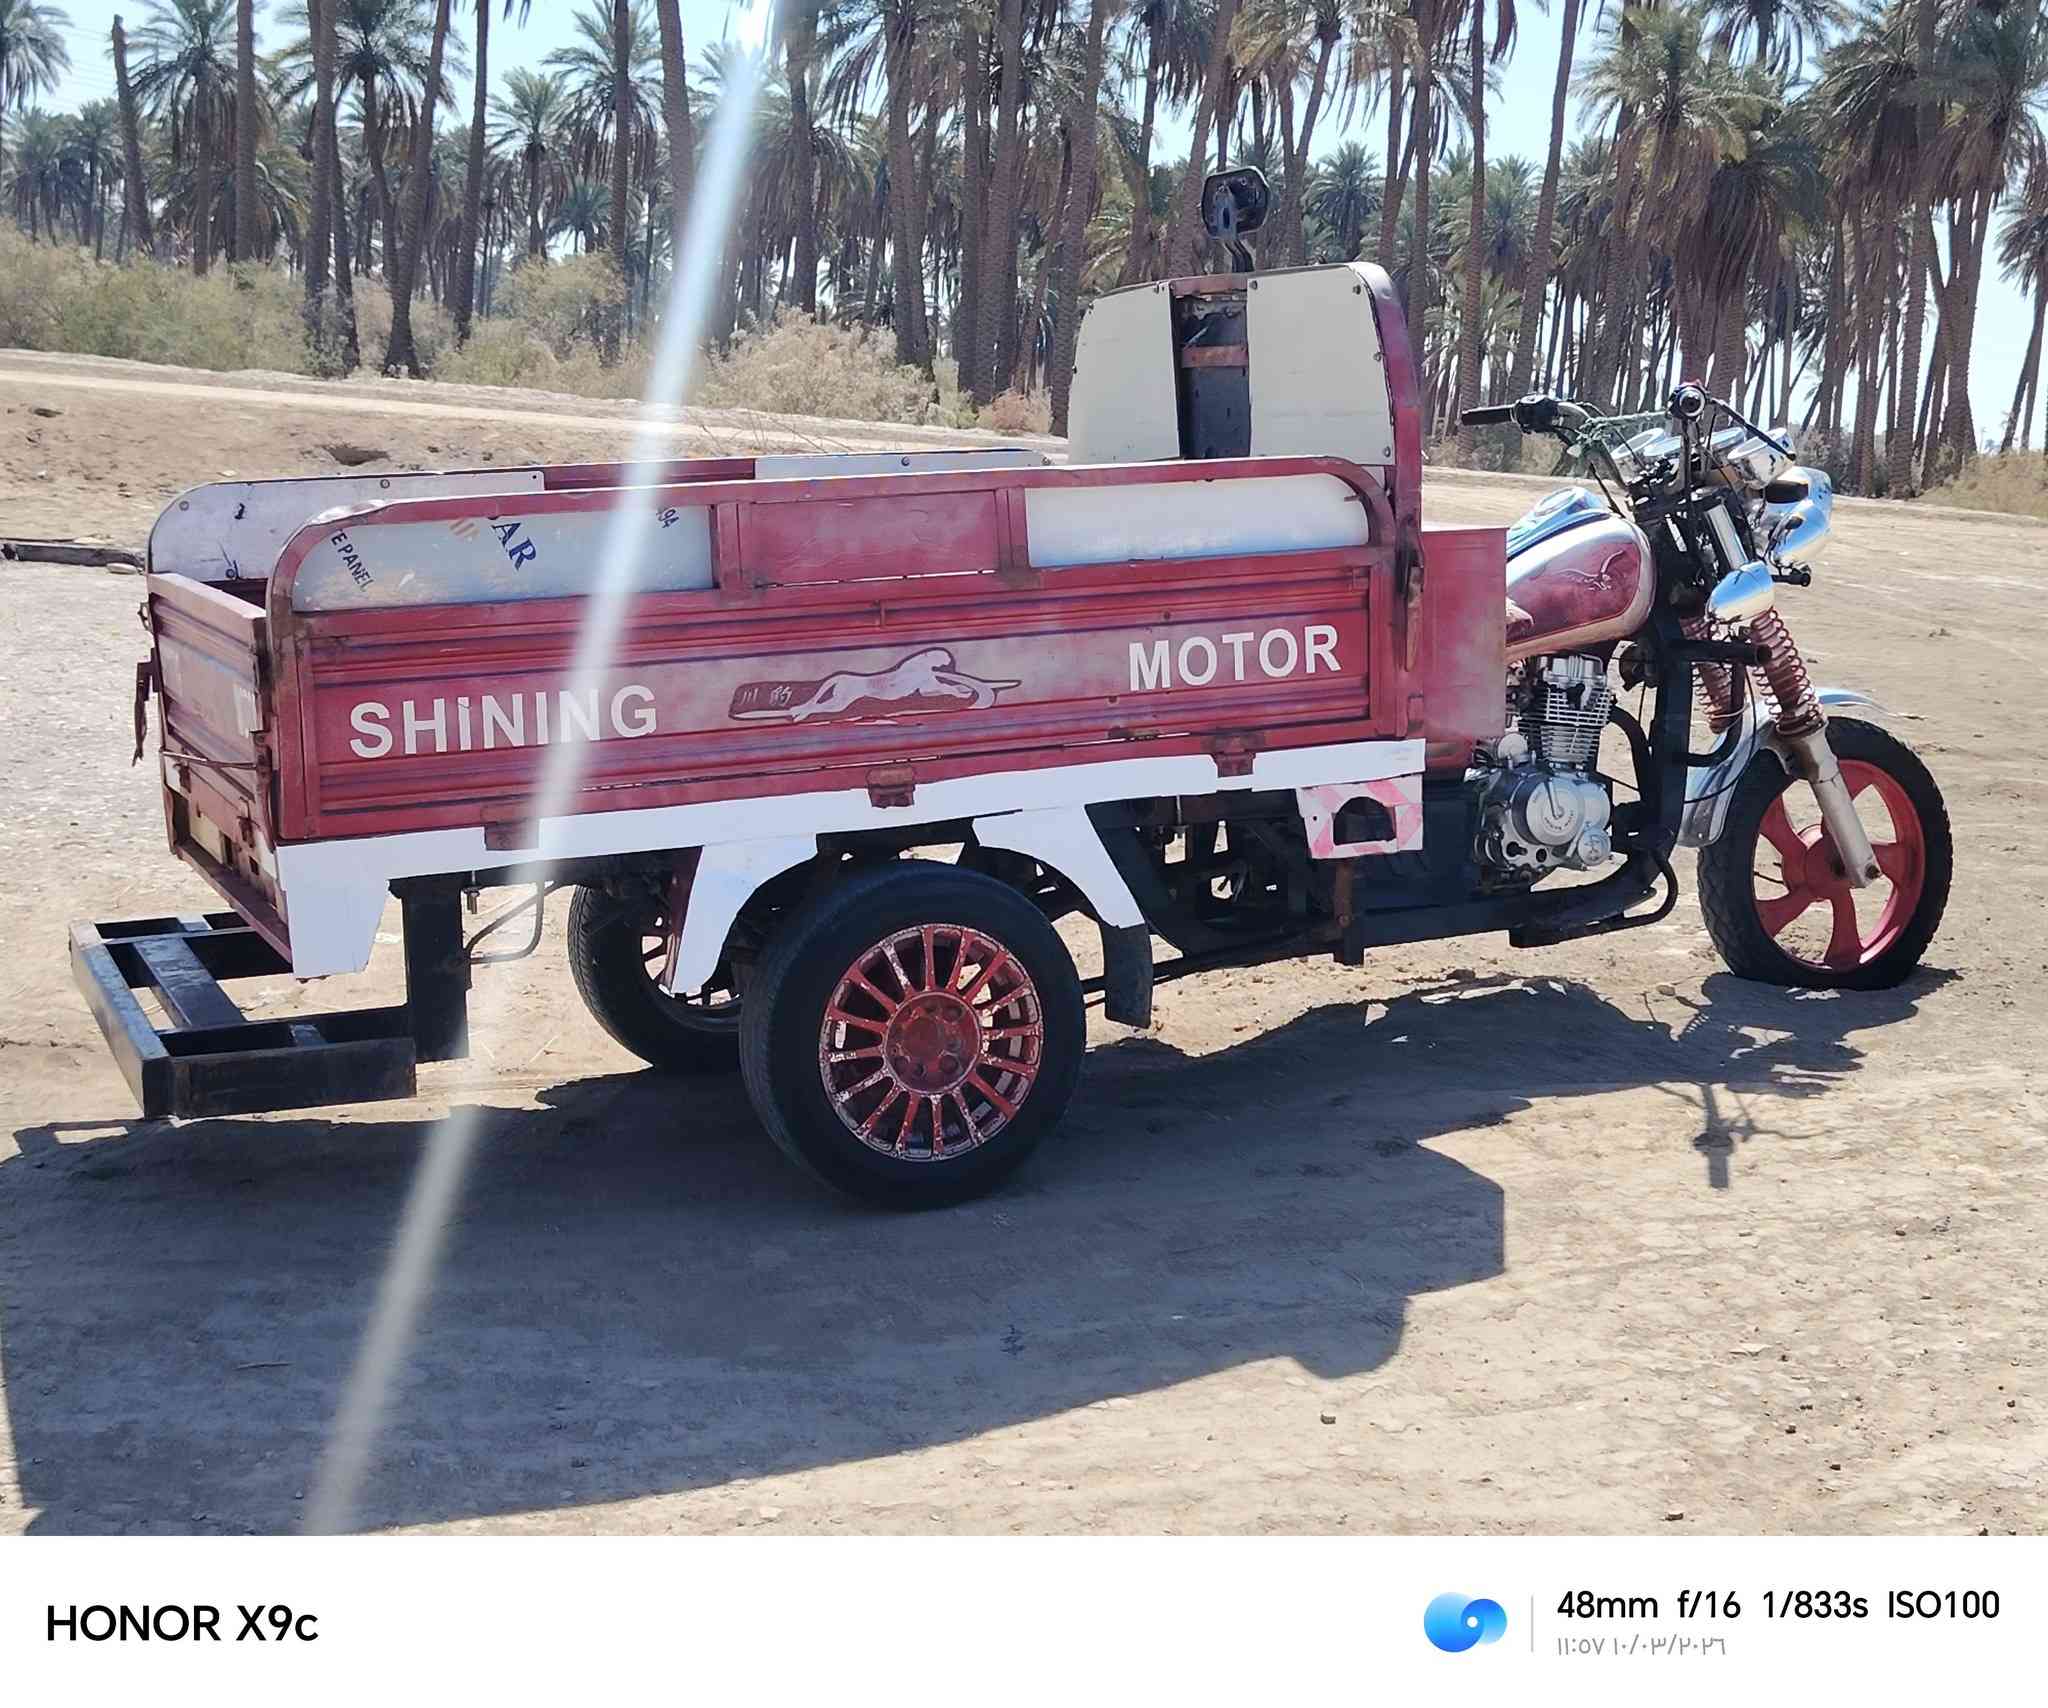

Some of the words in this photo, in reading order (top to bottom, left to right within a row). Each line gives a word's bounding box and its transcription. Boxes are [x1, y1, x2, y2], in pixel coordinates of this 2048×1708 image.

[331, 528, 348, 546] E
[490, 522, 536, 571] AR
[337, 543, 375, 592] PANEL
[1128, 624, 1342, 692] MOTOR
